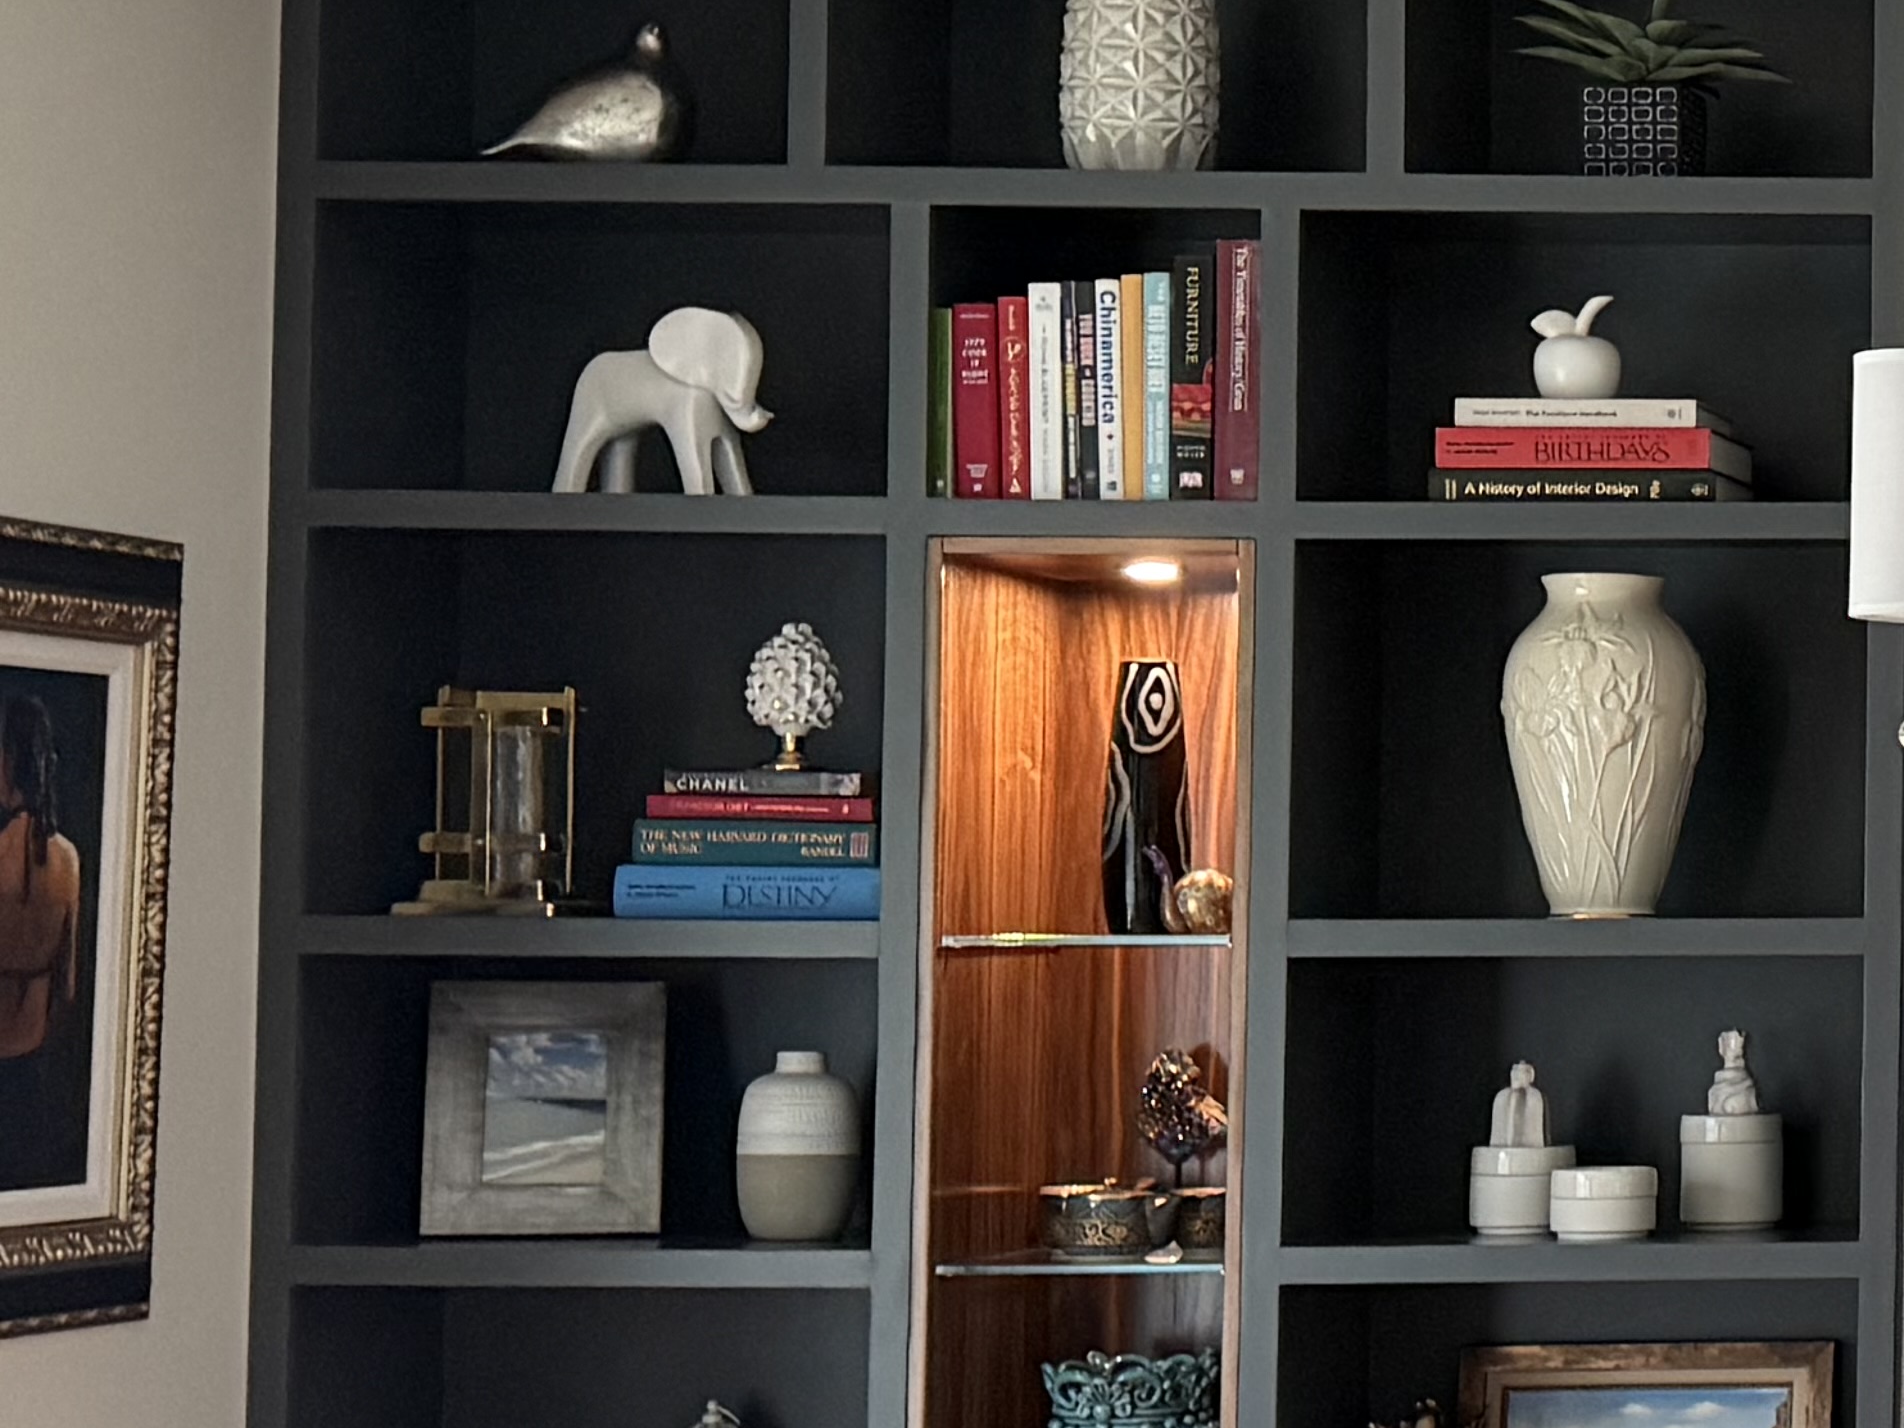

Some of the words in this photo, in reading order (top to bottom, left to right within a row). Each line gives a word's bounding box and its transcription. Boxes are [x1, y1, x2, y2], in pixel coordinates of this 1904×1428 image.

[1184, 266, 1200, 365] FURNITURE
[1099, 290, 1118, 424] Chinamerica
[1535, 439, 1671, 463] BIRTHDAYS
[1464, 482, 1476, 495] A
[1478, 482, 1525, 498] History
[1526, 481, 1541, 495] of
[1544, 481, 1591, 495] Interior
[1595, 482, 1640, 498] Design
[675, 776, 750, 792] CHANEL
[641, 828, 667, 841] THE
[671, 829, 702, 841] NEW
[706, 829, 767, 843] HARVARD
[771, 831, 846, 845] DICTIONARY
[640, 842, 656, 855] OF
[661, 842, 703, 855] MUSIC
[722, 883, 838, 910] DESTINY
